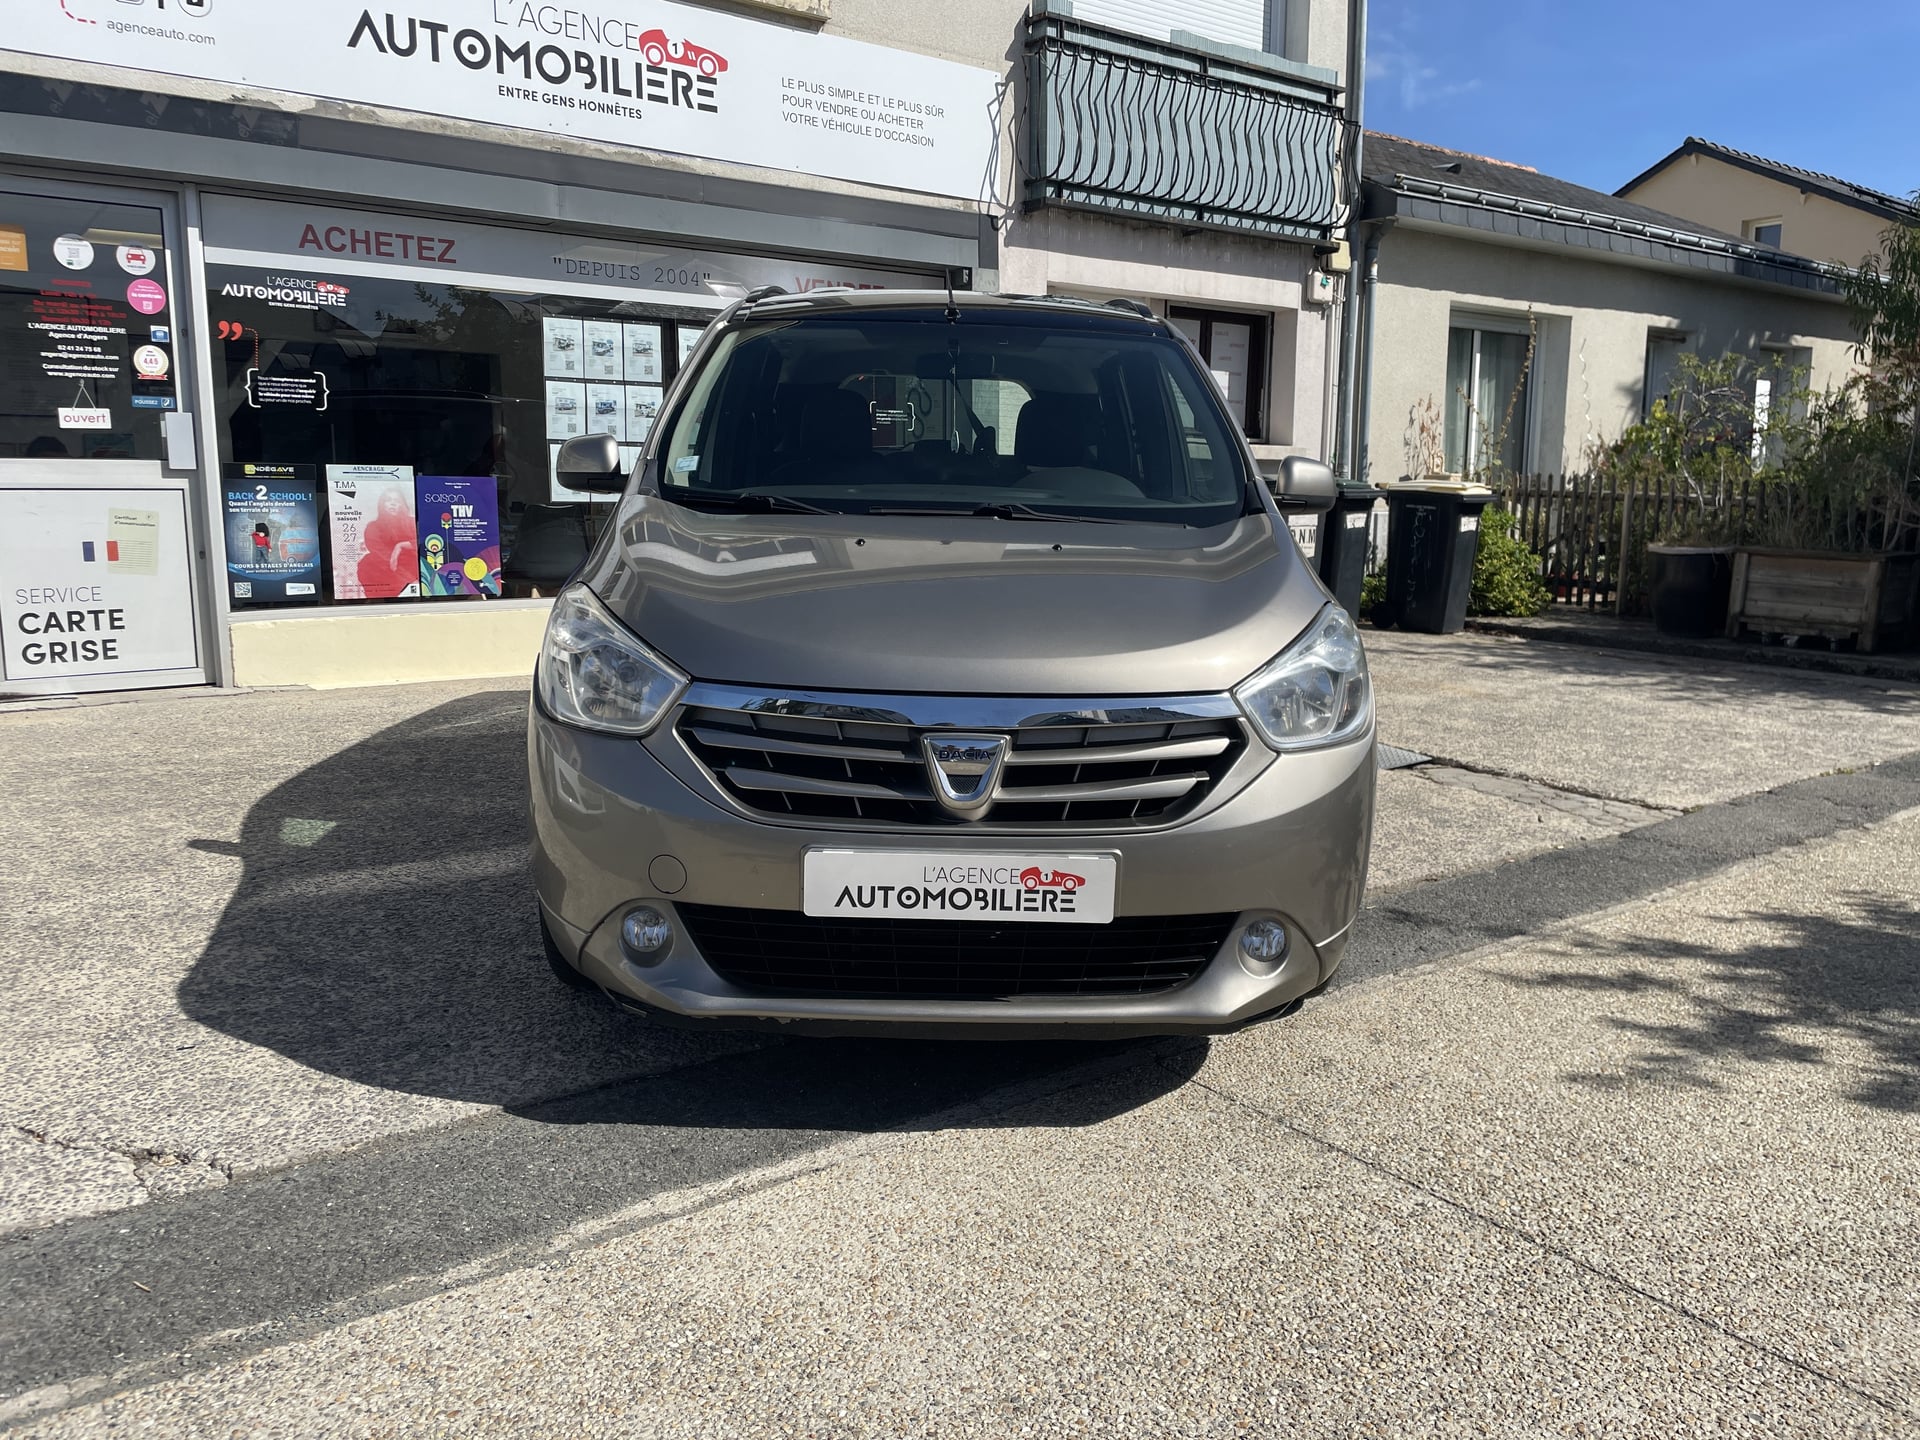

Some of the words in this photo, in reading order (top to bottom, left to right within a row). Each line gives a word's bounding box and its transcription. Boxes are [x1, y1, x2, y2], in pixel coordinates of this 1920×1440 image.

[106, 20, 216, 46] agenceauto.com
[671, 42, 679, 55] 1
[498, 85, 538, 102] ENTRE
[542, 93, 575, 108] GENS
[579, 98, 643, 120] HONNÊTES
[782, 77, 795, 89] LE
[798, 80, 825, 95] PLUS
[828, 86, 865, 103] SIMPLE
[868, 94, 880, 105] ET
[883, 97, 895, 108] LE
[897, 99, 922, 114] PLUS
[924, 105, 944, 118] SÛR
[782, 94, 813, 110] POUR
[815, 100, 858, 118] VENDRE
[860, 109, 876, 121] OU
[877, 112, 924, 130] ACHETER
[782, 111, 819, 127] VOTRE
[821, 117, 872, 137] VÉHICULE
[874, 127, 934, 148] D'OCCASION
[298, 223, 457, 264] ACHETEZ
[266, 276, 317, 290] L'AGENCE
[28, 322, 66, 331] L'AGENCE
[48, 331, 76, 339] Agence
[77, 332, 108, 341] d'Angers
[63, 413, 106, 423] ouvert
[228, 492, 255, 500] BACK
[255, 485, 268, 500] 2
[269, 492, 307, 501] SCHOOL
[425, 493, 466, 504] saison
[342, 523, 357, 532] 26
[343, 533, 358, 542] 27
[16, 586, 103, 605] SERVICE
[18, 609, 126, 635] CARTE
[22, 639, 119, 665] GRISE
[938, 750, 991, 761] DACIA
[923, 866, 1020, 885] L'AGENCE
